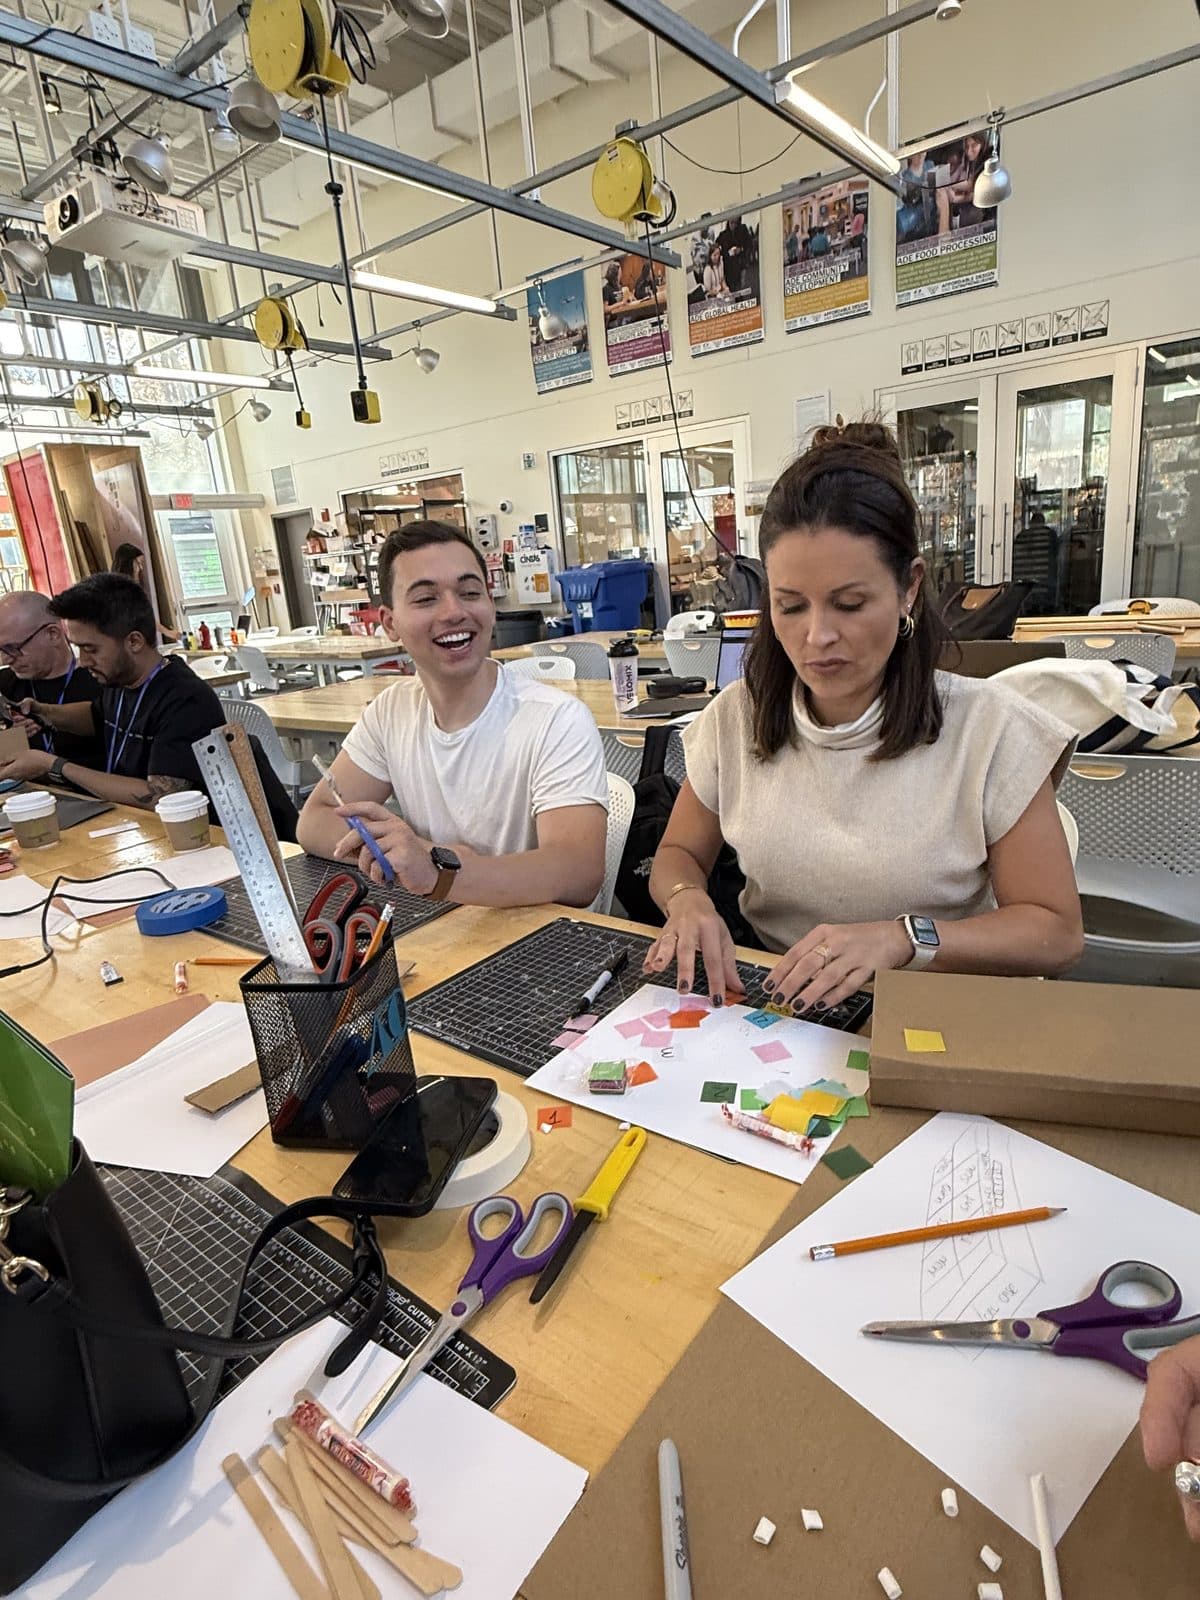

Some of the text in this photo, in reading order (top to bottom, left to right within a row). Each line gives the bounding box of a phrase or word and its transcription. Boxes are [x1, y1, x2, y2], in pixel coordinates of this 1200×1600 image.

[897, 232, 995, 265] ADE FOOD PROCESSING
[802, 262, 849, 282] COMMUNITY
[785, 275, 840, 295] DEVELOPMENT
[704, 308, 730, 320] GLOBAL
[730, 300, 756, 311] HEALTH
[625, 664, 634, 704] VELOMIX
[548, 1110, 562, 1125] 1
